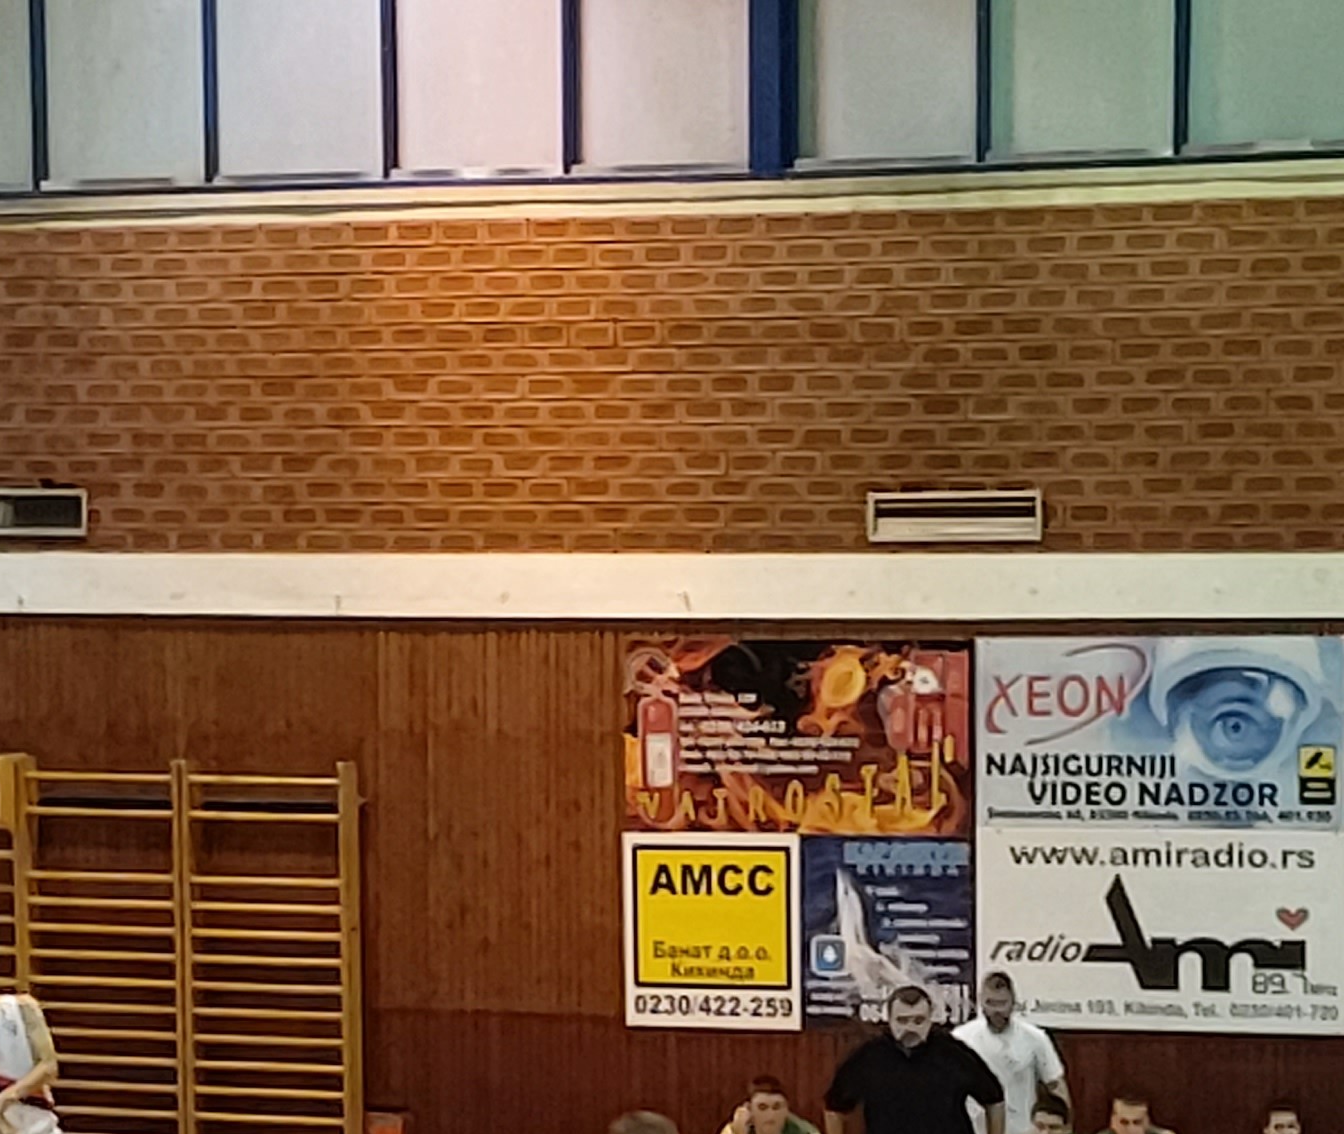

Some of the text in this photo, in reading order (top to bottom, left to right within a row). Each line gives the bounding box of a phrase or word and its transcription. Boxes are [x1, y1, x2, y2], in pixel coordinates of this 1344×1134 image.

[985, 673, 1129, 733] XEON
[986, 753, 1177, 778] NAJSIGURNIJI
[1029, 782, 1279, 807] VIDEO NADZOR
[1010, 842, 1316, 870] www.amiradio.rs
[990, 873, 1306, 991] radio Ami
[652, 940, 713, 960] Банат
[670, 963, 755, 981] Кикинда
[634, 994, 794, 1018] 0230/422-259
